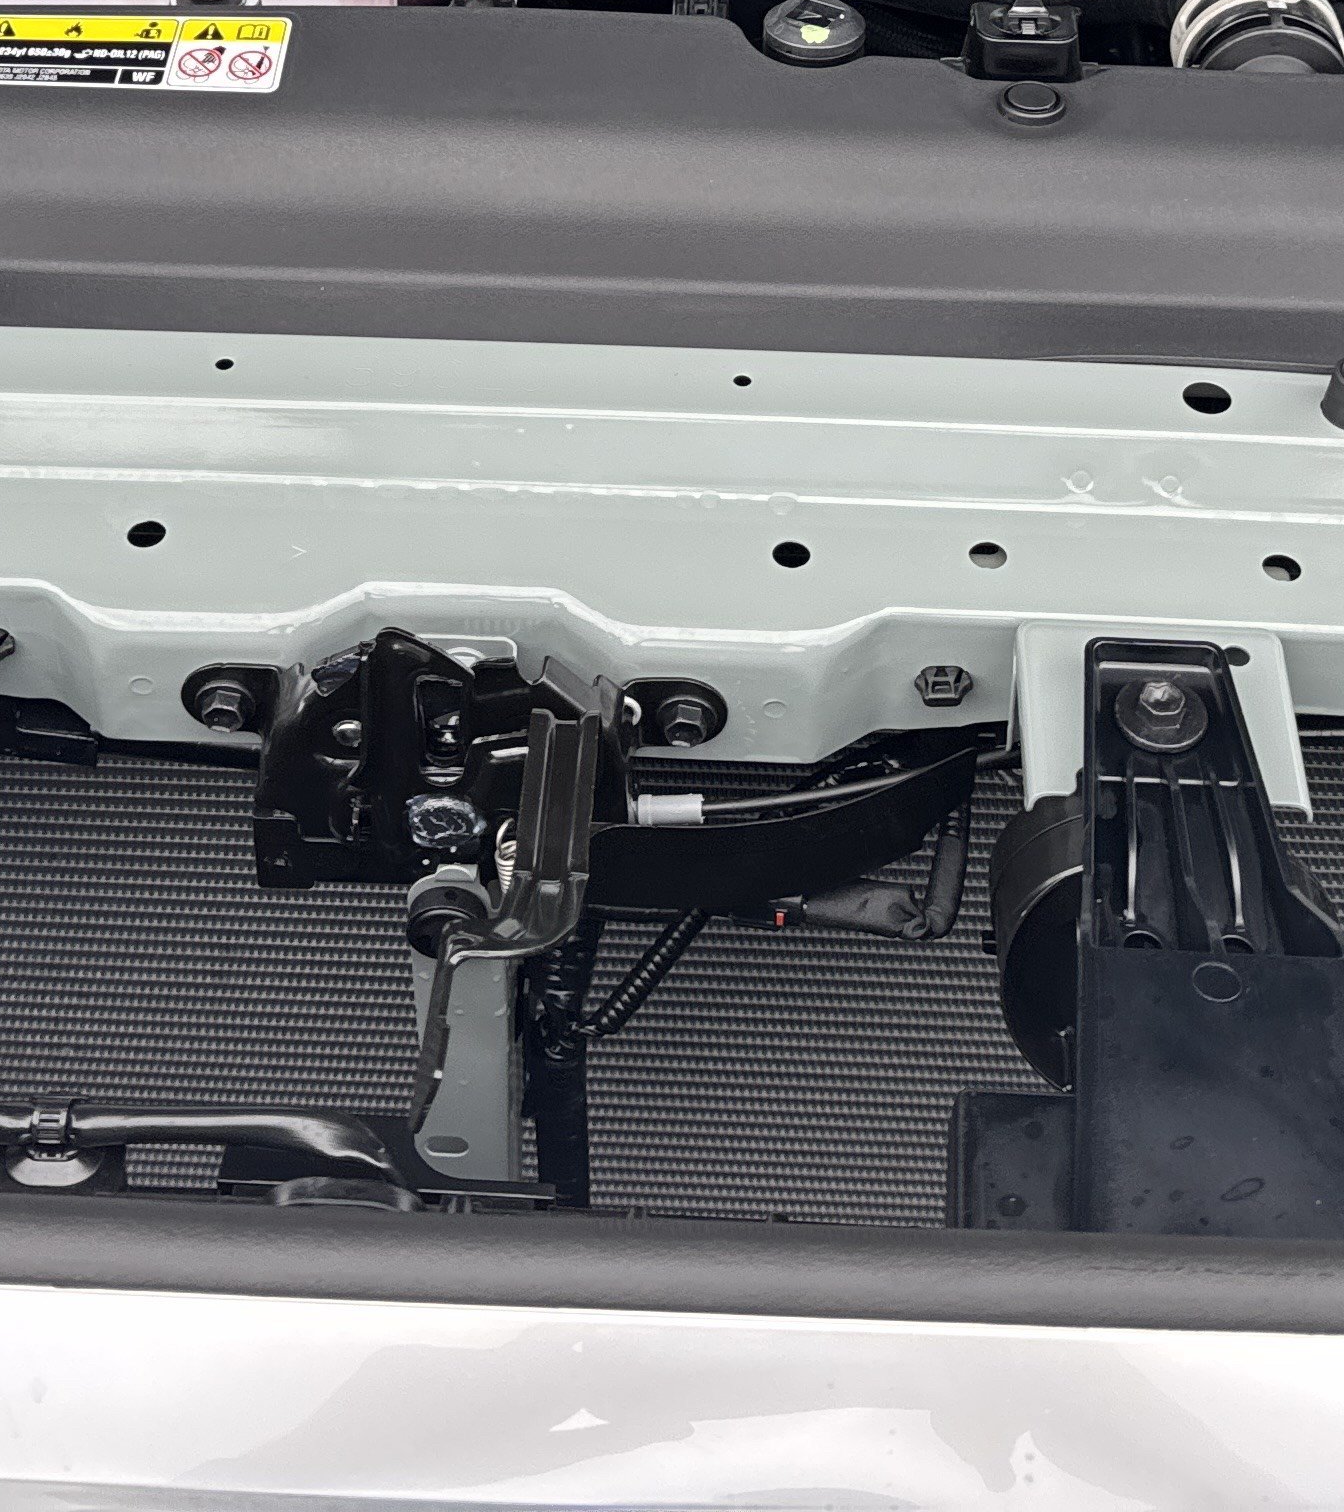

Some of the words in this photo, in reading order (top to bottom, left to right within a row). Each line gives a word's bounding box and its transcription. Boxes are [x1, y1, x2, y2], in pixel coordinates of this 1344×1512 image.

[138, 50, 166, 61] (PAG)
[39, 68, 91, 76] CORPORATION
[131, 71, 156, 83] WF
